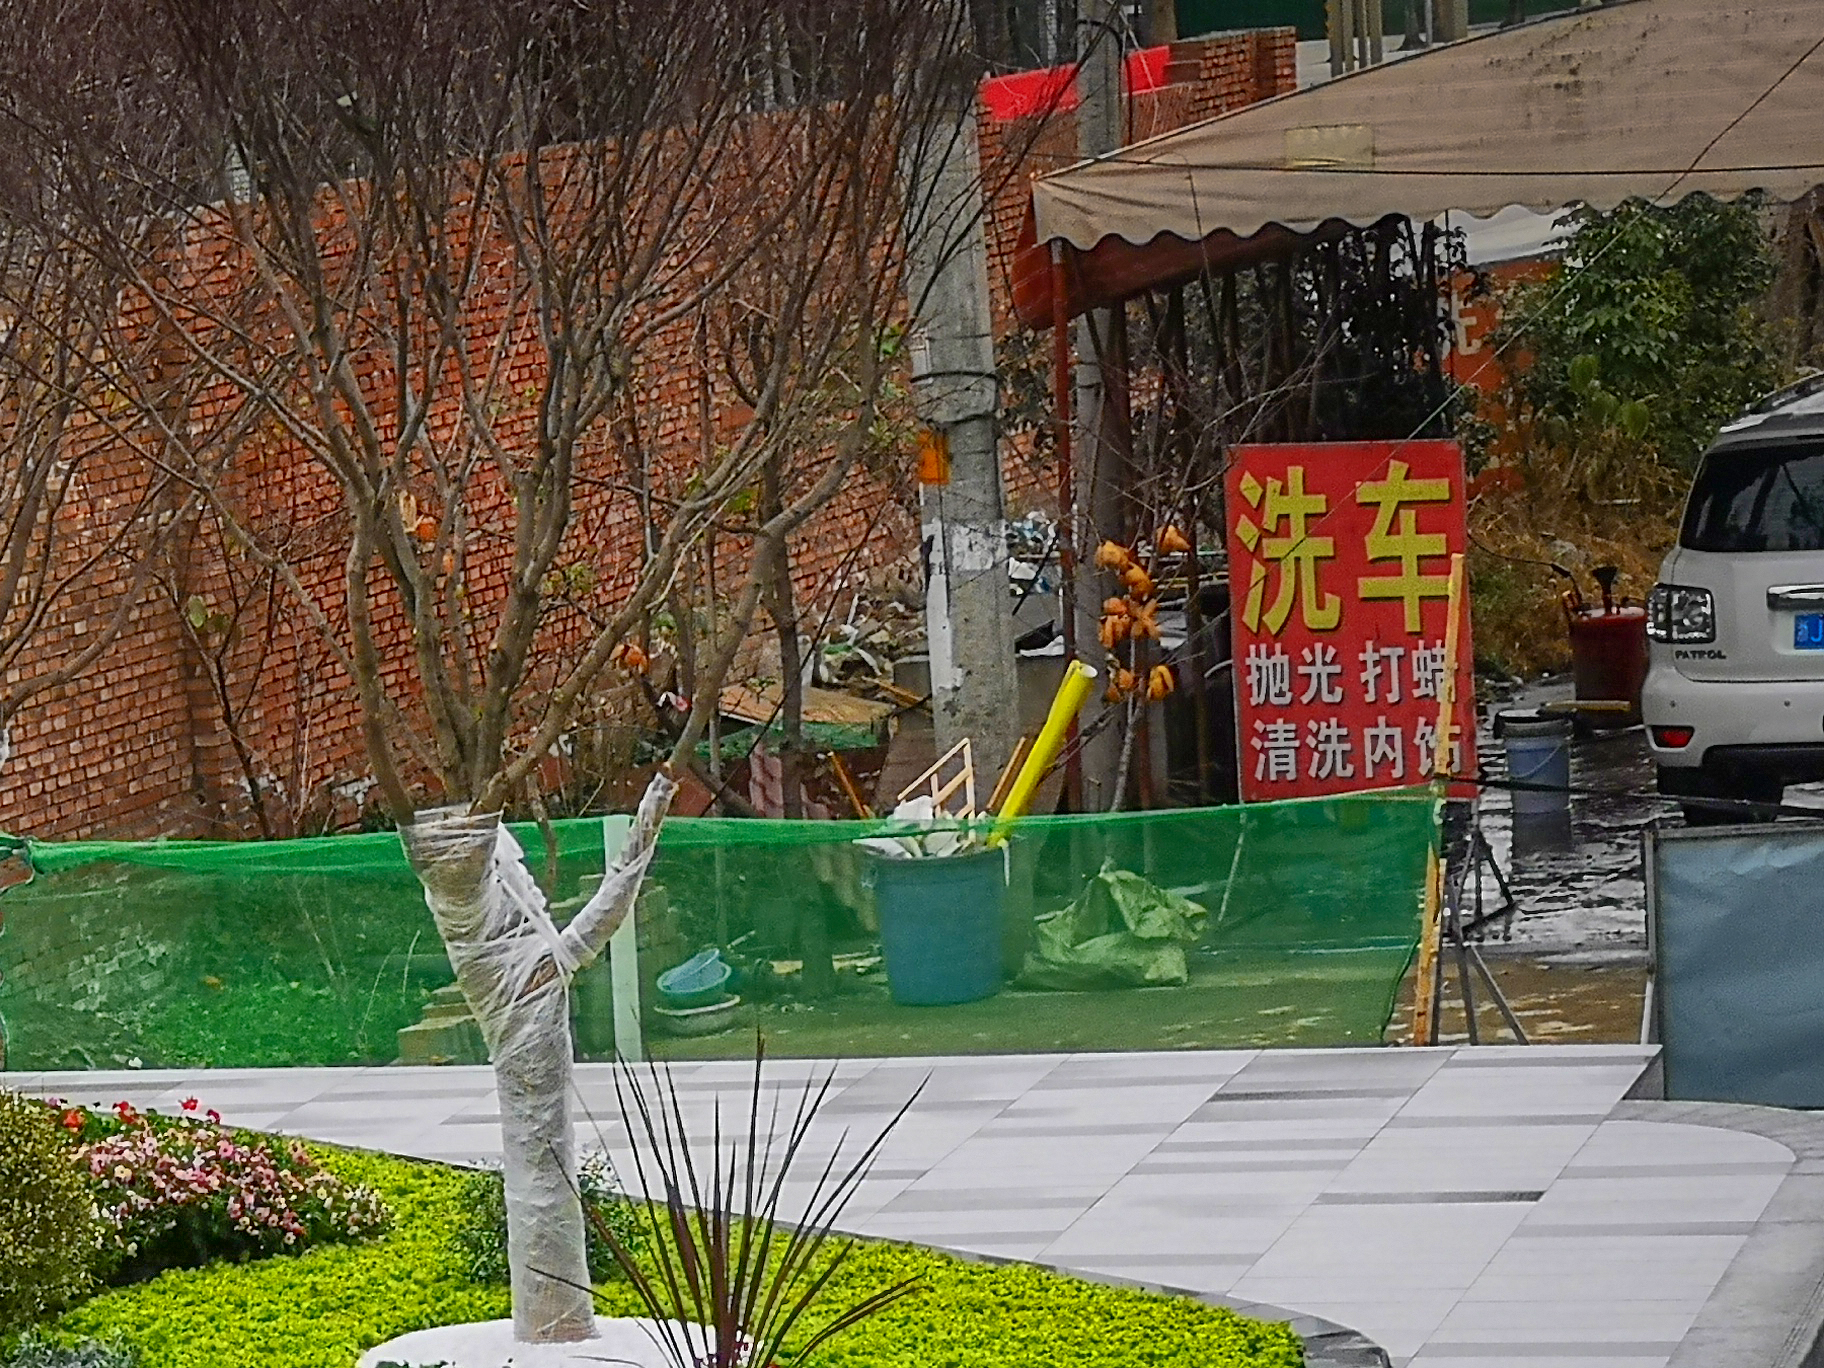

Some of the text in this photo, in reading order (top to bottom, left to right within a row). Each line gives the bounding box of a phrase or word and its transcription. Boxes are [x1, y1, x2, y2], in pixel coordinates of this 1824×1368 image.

[1235, 459, 1451, 636] 洗车
[1675, 650, 1727, 660] PATROL
[1250, 715, 1461, 781] 清洗内饰
